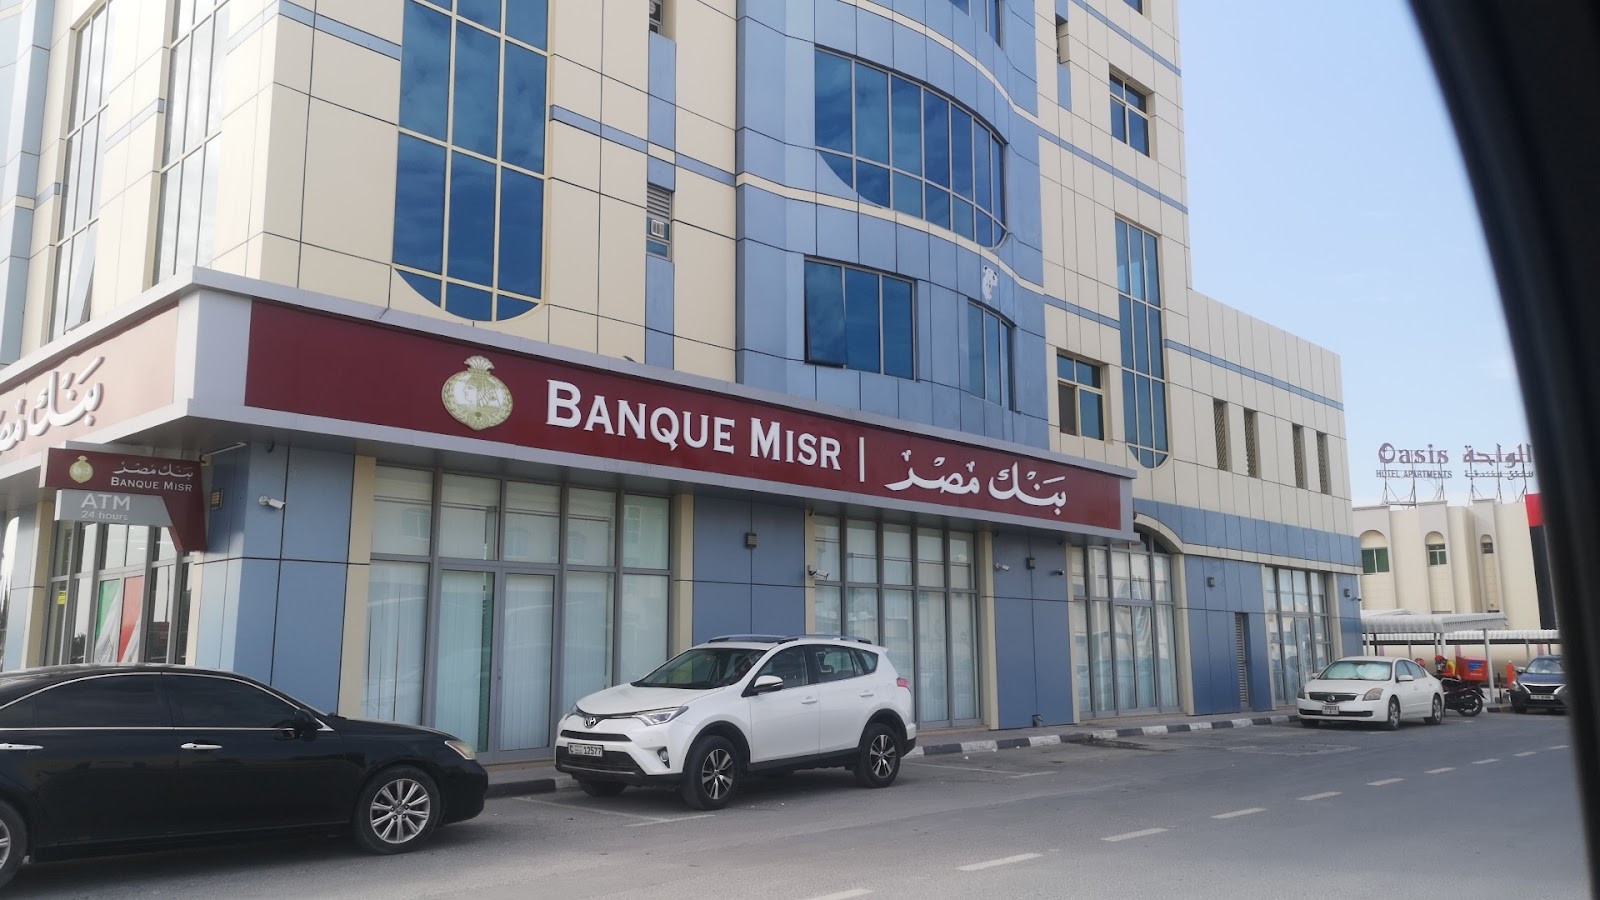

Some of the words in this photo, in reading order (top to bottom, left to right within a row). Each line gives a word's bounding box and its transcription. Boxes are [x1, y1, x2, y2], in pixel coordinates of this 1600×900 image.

[546, 379, 735, 454] BANQUE
[750, 417, 841, 470] MISR
[1378, 442, 1449, 464] Oasis
[1463, 443, 1533, 468] الواحة
[1376, 469, 1400, 478] HOTEL
[1403, 469, 1453, 479] APARTMENTS
[110, 476, 159, 490] BANQUE
[163, 481, 193, 492] MISR
[80, 493, 131, 511] ATM
[82, 511, 95, 519] 24
[98, 511, 129, 521] hours
[583, 746, 602, 756] 12577
